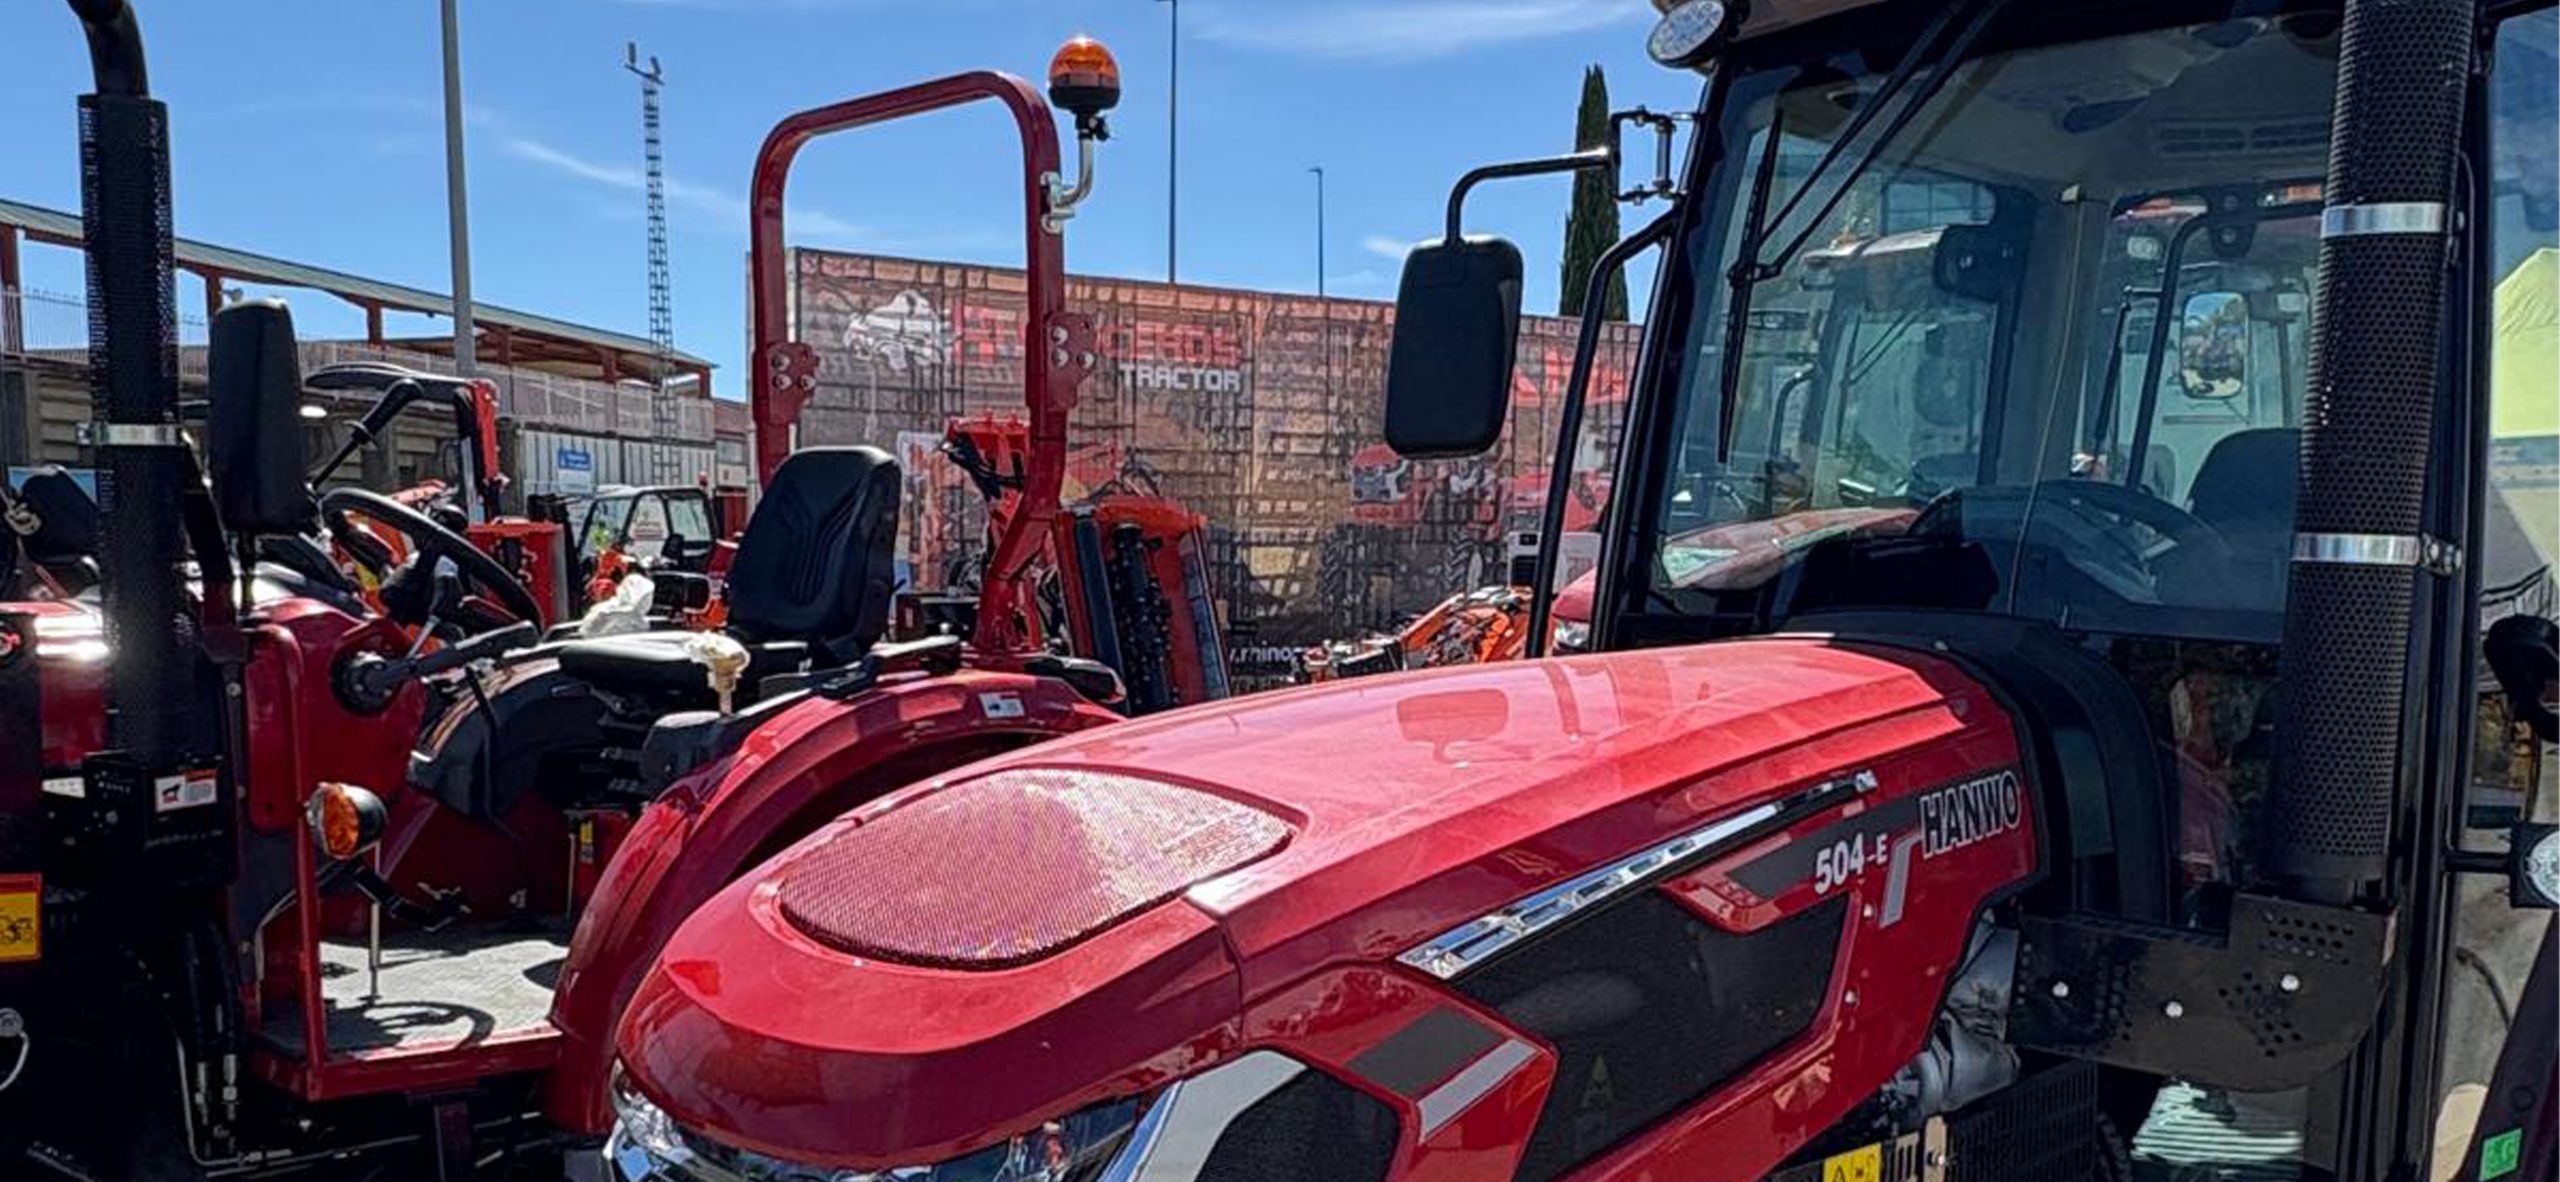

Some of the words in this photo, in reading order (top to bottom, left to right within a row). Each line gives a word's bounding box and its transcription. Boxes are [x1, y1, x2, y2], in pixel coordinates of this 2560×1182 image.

[1118, 363, 1241, 393] TRACTOR
[1814, 831, 1888, 894] 504-E
[1919, 770, 2021, 860] HANWO
